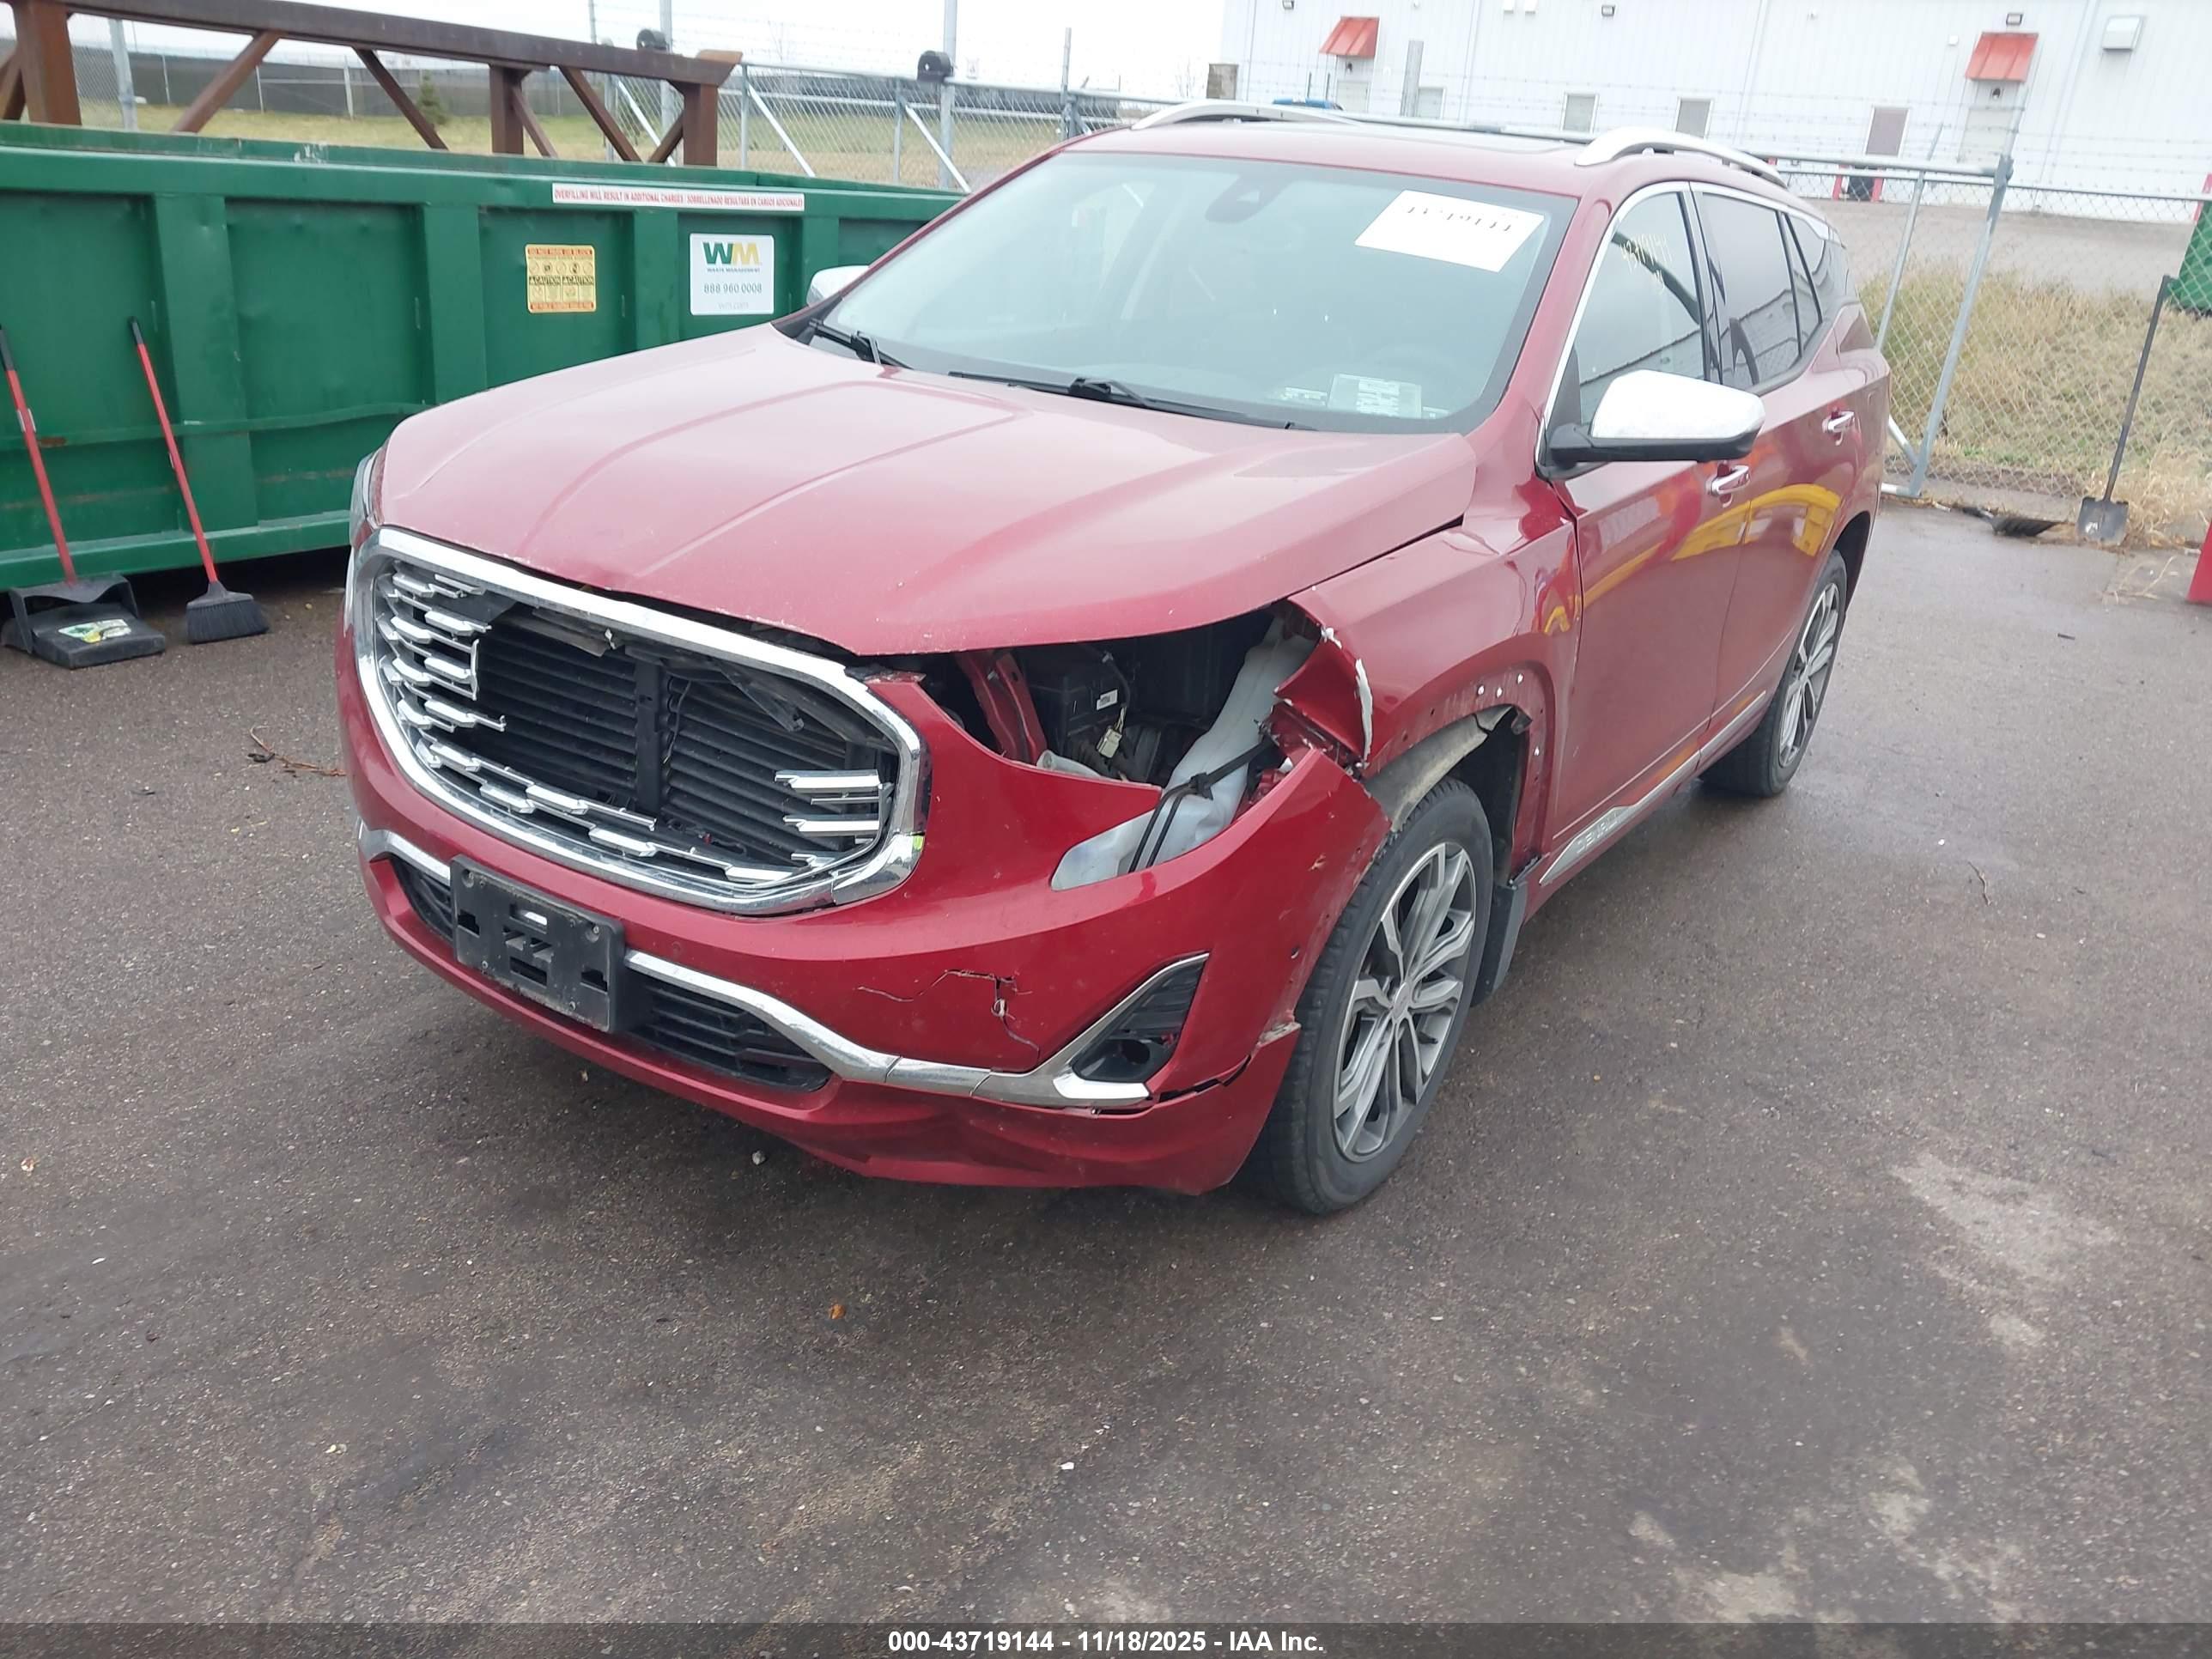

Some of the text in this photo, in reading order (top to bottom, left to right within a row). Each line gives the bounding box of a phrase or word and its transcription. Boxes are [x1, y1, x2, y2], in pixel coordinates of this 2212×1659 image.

[555, 190, 588, 200] OVERFILLING
[590, 191, 601, 201] WILL
[604, 191, 623, 201] RESULT
[631, 192, 659, 203] ADDITIONAL
[660, 193, 683, 204] CHARGES
[702, 242, 760, 264] WM
[704, 283, 763, 294] 888 960 0008
